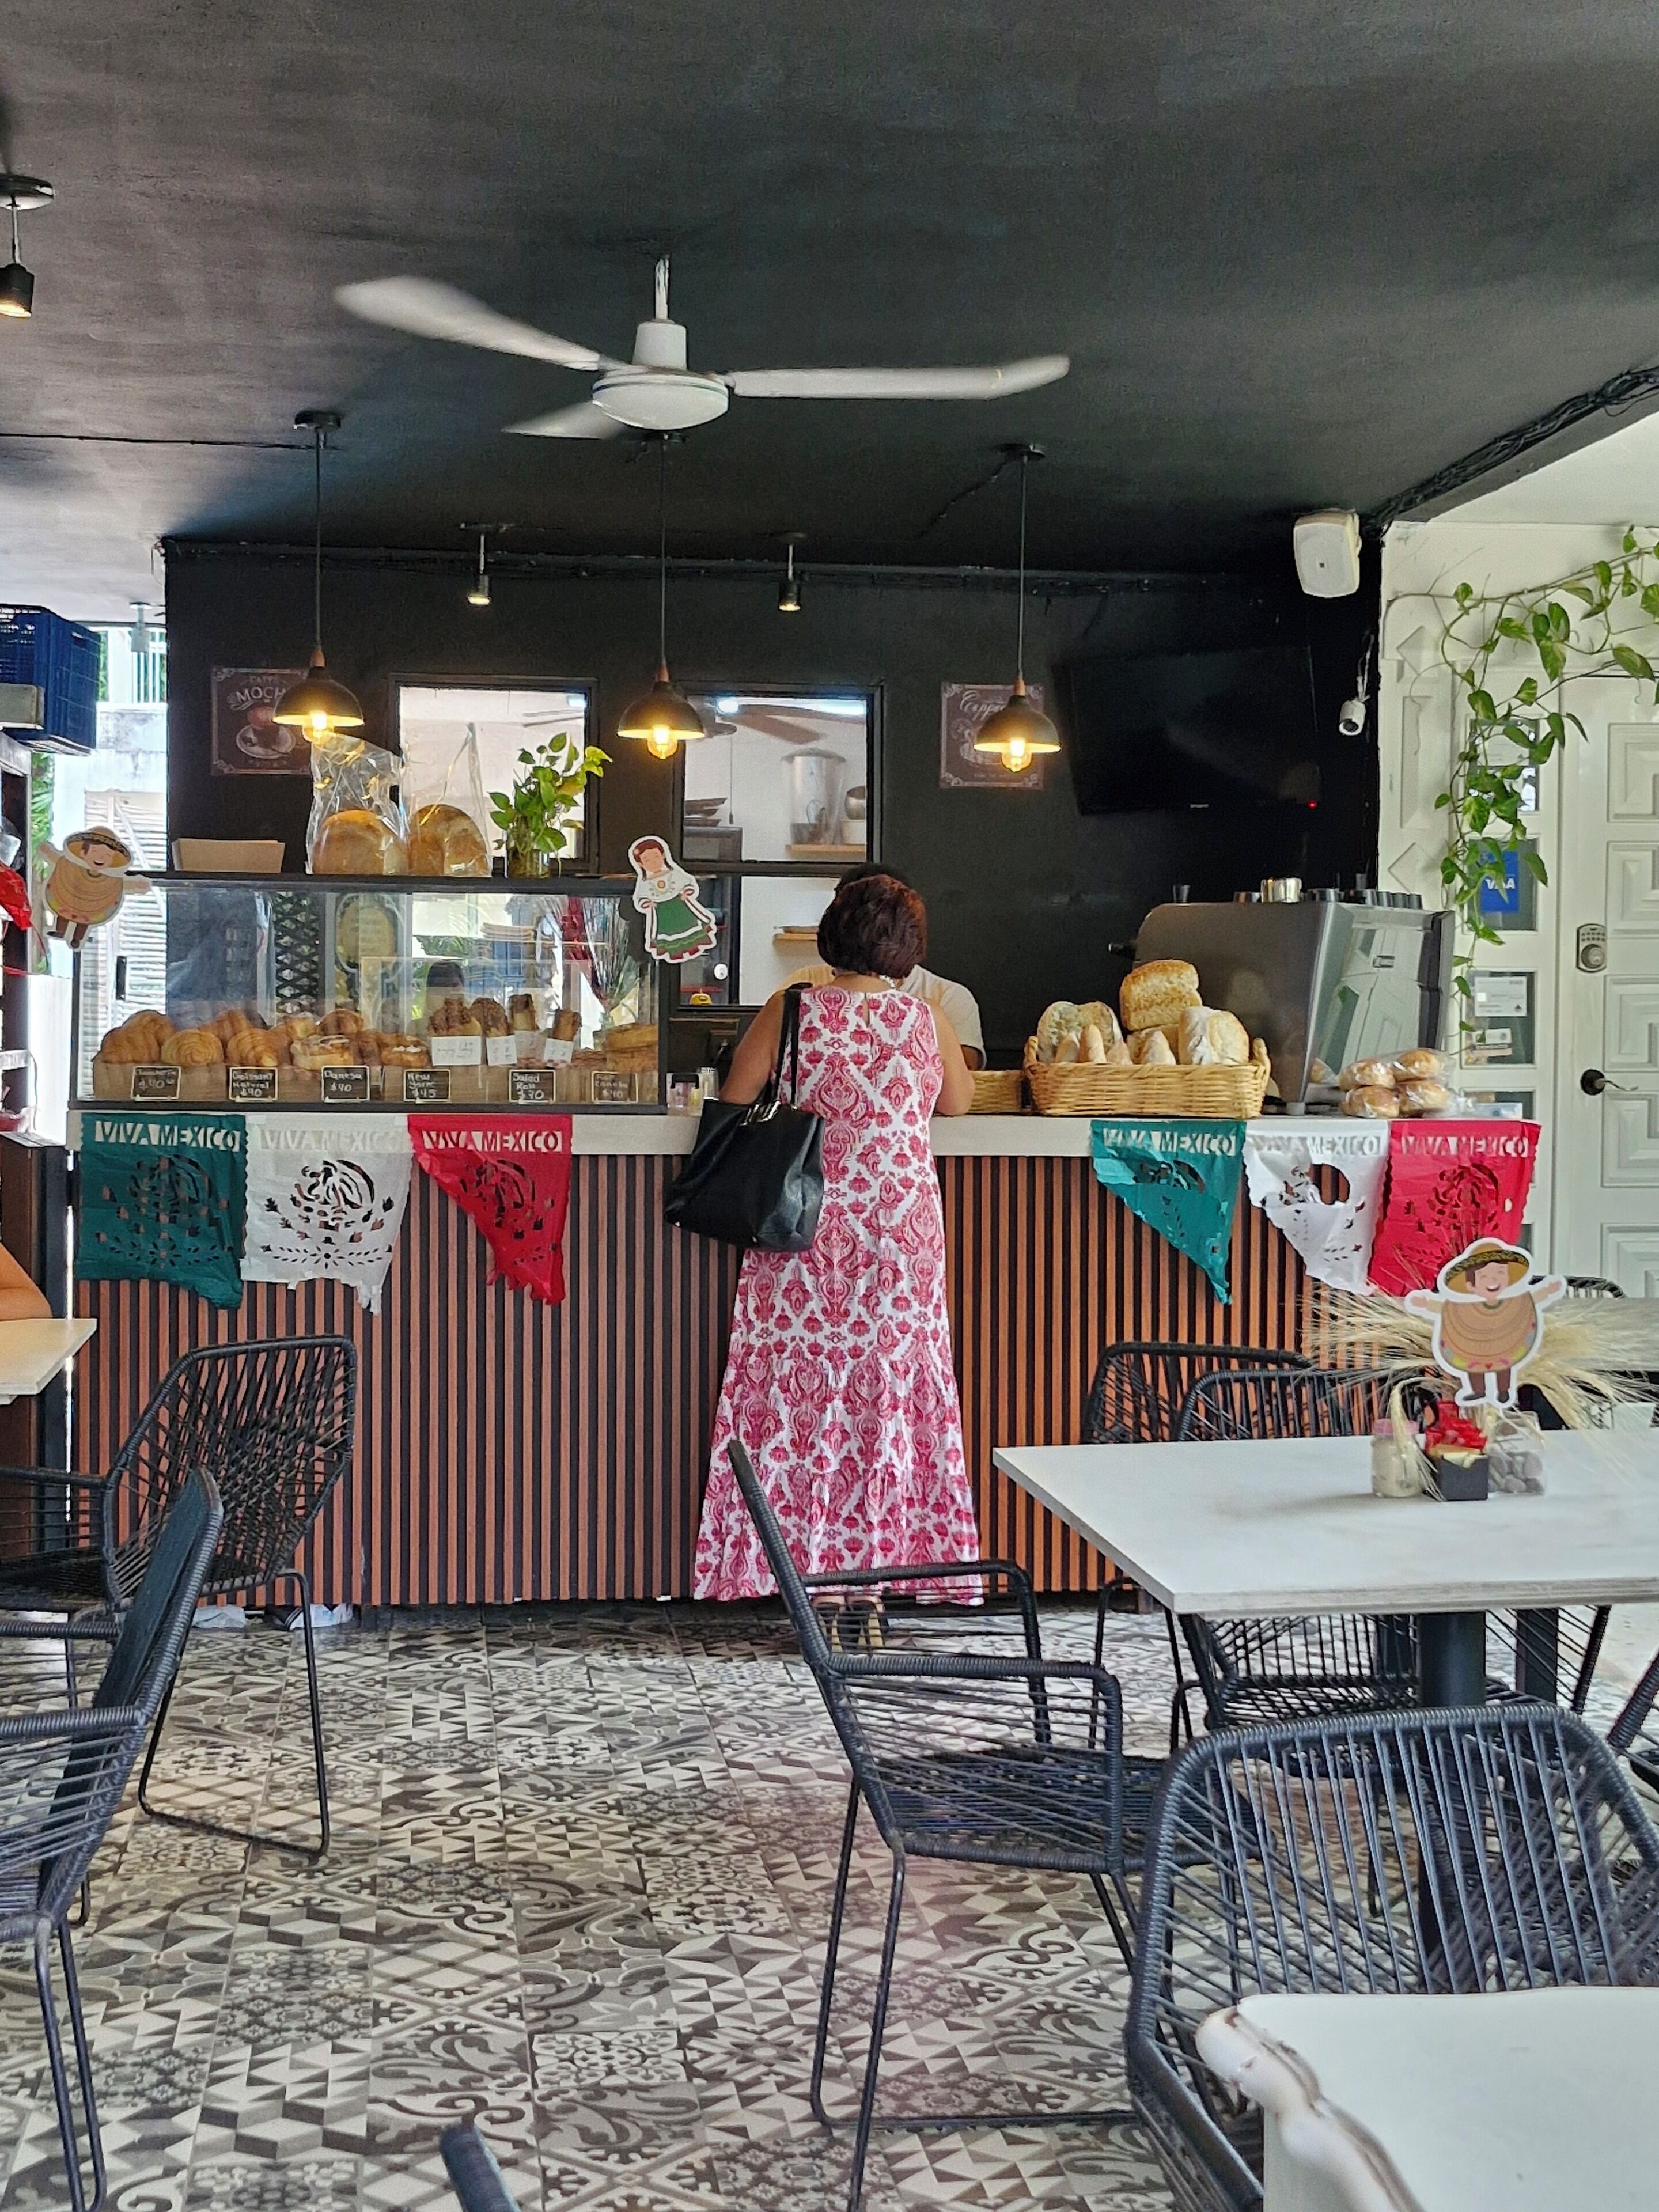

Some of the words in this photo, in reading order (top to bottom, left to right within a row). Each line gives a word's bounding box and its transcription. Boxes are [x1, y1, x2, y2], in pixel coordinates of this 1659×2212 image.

[236, 687, 286, 703] MOCH
[1484, 878, 1516, 890] VA
[95, 1120, 153, 1145] VIVA
[157, 1124, 241, 1152] MEXICO
[261, 1129, 318, 1150] VIVA
[422, 1130, 479, 1152] VIVA
[480, 1131, 562, 1153] MEXICO
[1103, 1128, 1157, 1150] VIVA
[1158, 1131, 1236, 1157] MEXICO
[1307, 1135, 1381, 1156] MEXICO
[1401, 1135, 1455, 1155] VIVA
[1457, 1135, 1529, 1158] MEXICO
